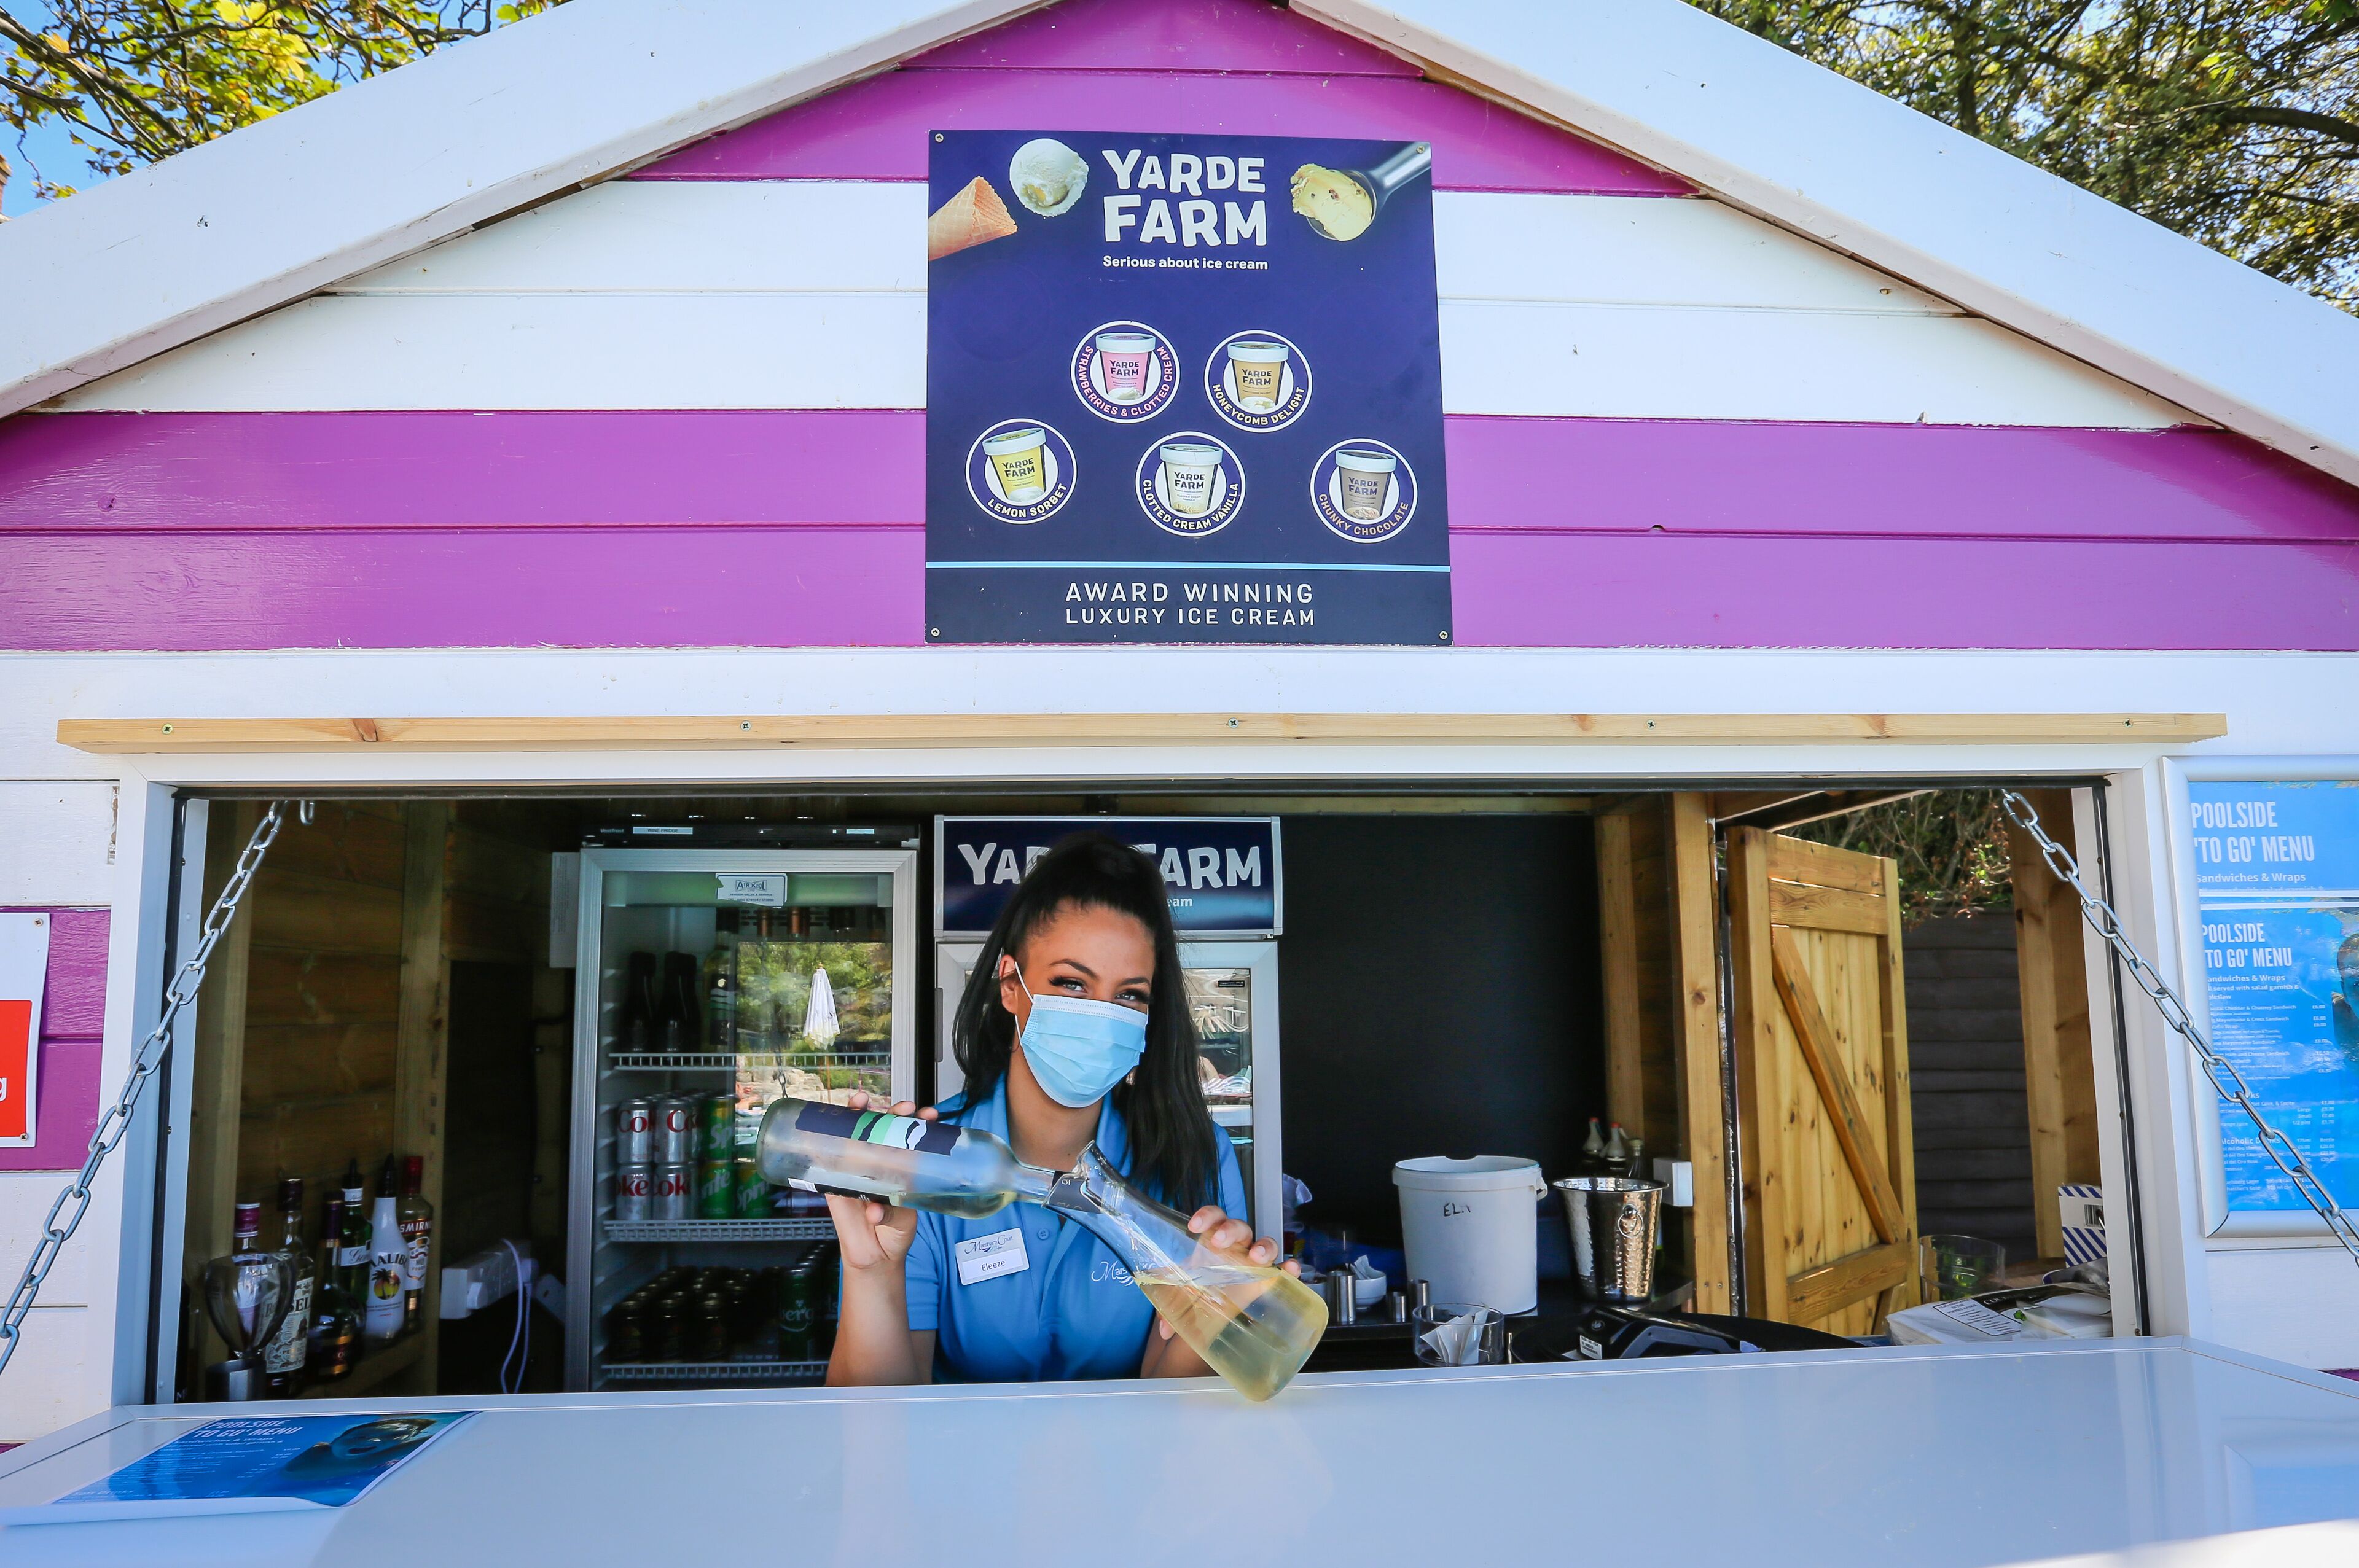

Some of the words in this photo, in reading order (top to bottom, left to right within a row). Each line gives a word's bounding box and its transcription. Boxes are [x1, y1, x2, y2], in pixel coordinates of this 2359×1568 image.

[1101, 149, 1266, 196] YARDE
[1103, 195, 1267, 247] FARM
[1103, 255, 1156, 268] Serious
[1159, 257, 1199, 268] about
[1202, 258, 1222, 269] ice
[1225, 261, 1268, 270] cream
[1109, 360, 1139, 369] YARDE
[1110, 368, 1139, 376] FARM
[1242, 369, 1272, 377] YARDE
[1078, 346, 1118, 415] STRAWBERRIES
[1131, 384, 1170, 416] CLOTTED
[1157, 346, 1173, 382] CREAM
[1242, 376, 1271, 386] FARM
[1212, 384, 1268, 426] HONEYCOMB
[1270, 387, 1305, 424] DELIGHT
[1002, 458, 1033, 469] YARDE
[1004, 465, 1035, 477] FARM
[1174, 472, 1205, 481] YARDE
[1175, 480, 1204, 490] FARM
[1348, 477, 1379, 487] YARDE
[1348, 485, 1377, 496] FARM
[987, 498, 1027, 518] LEMON
[1030, 483, 1067, 517] SORBET
[1143, 480, 1172, 523] CLOTTED
[1173, 518, 1211, 530] CREAM
[1211, 483, 1239, 523] VANILLA
[1319, 494, 1352, 531] CHUNKY
[1354, 502, 1409, 536] CHOCOLATE
[1065, 583, 1168, 602] AWARD
[1183, 583, 1313, 603] WINNING
[1066, 607, 1166, 624] LUXURY
[1178, 609, 1218, 624] ICE
[1231, 609, 1315, 625] CREAM
[2191, 802, 2278, 829] POOLSIDE
[2226, 837, 2255, 862] GO'
[2261, 836, 2315, 862] MENU
[2272, 873, 2306, 884] Wraps
[736, 881, 749, 891] AIR
[2226, 948, 2248, 968] GO'
[2253, 948, 2292, 967] MENU
[2207, 975, 2250, 983] andwiches
[2259, 975, 2285, 983] Wraps
[997, 1234, 1014, 1246] Court
[981, 1260, 1006, 1271] Eleeze
[205, 1420, 290, 1429] POOLSIDE
[247, 1427, 302, 1436] MENU
